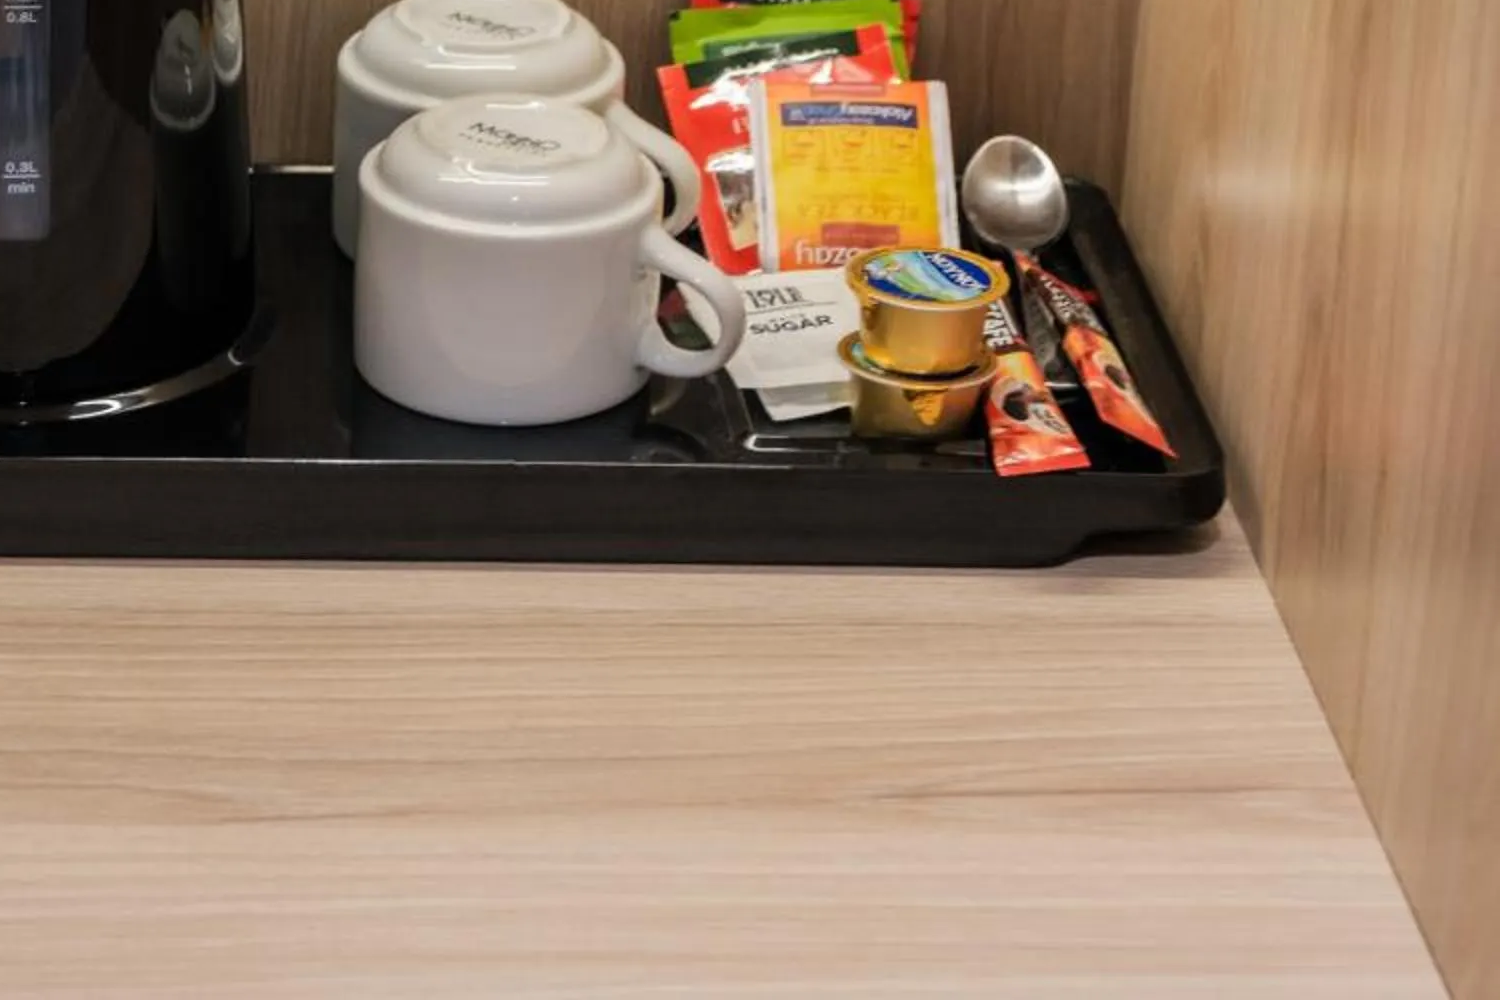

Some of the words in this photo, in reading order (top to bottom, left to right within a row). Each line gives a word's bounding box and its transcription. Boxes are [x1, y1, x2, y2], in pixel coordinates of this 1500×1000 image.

[5, 161, 38, 174] 0.3L
[7, 181, 35, 194] min
[749, 314, 834, 335] SUGAR
